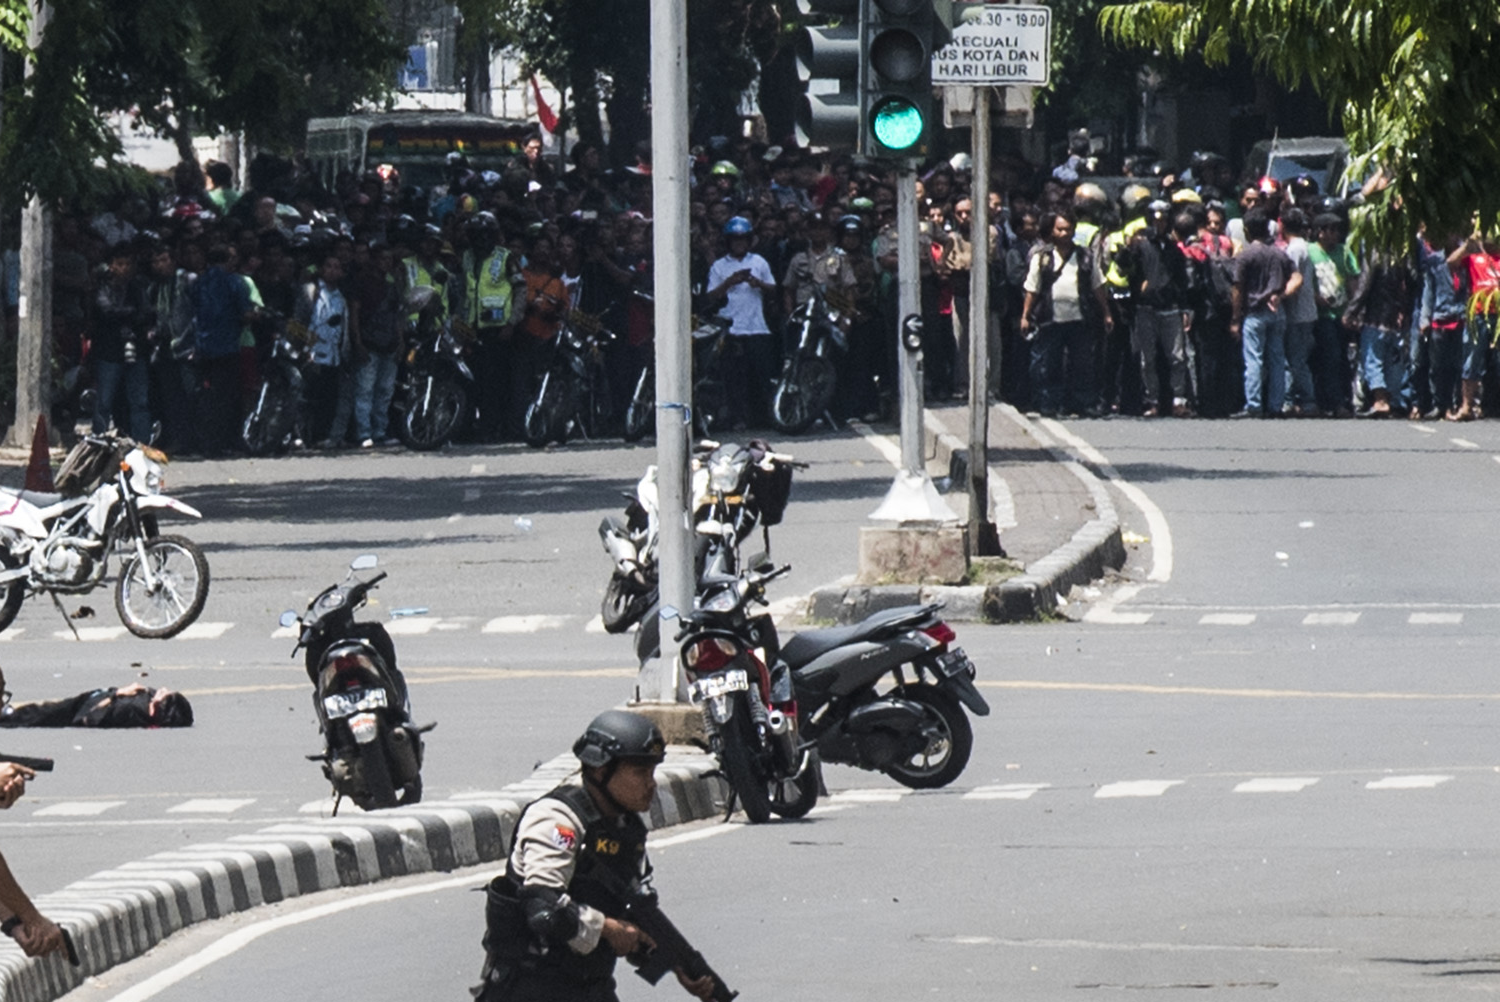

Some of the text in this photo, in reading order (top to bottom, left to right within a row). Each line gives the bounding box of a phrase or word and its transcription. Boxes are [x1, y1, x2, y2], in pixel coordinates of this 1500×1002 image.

[1016, 13, 1045, 27] 19.00
[951, 36, 1018, 47] KECUALI
[963, 49, 1003, 61] KOTA
[1009, 50, 1039, 61] DAN
[940, 64, 1028, 76] HARI LIBUR
[596, 838, 620, 855] K9
